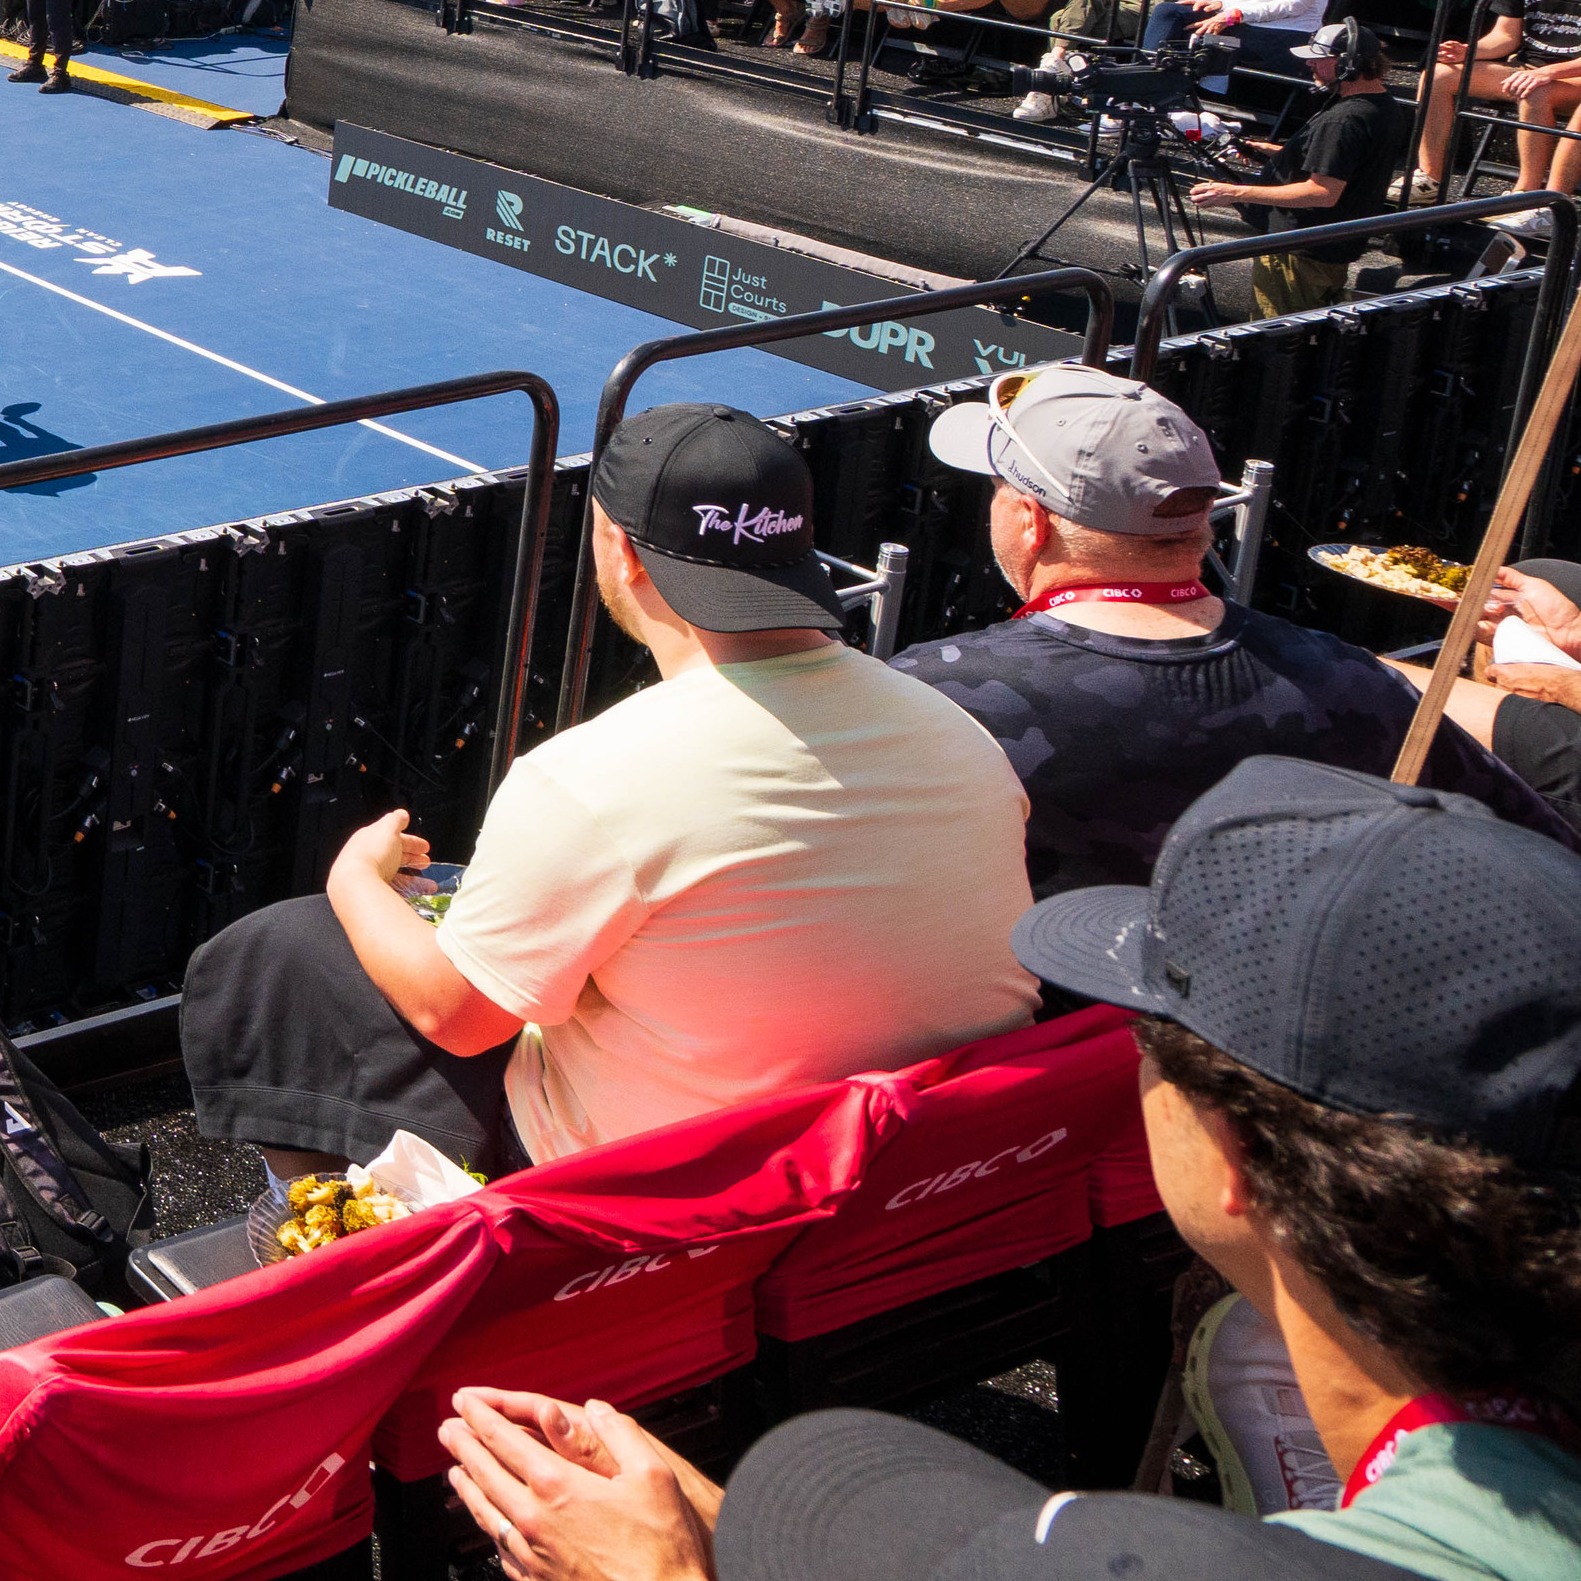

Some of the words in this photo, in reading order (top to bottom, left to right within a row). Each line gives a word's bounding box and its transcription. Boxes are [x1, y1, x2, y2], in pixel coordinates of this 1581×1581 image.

[364, 162, 468, 210] PICKLEBALL
[486, 227, 531, 252] RESET
[732, 267, 768, 290] Just
[730, 285, 788, 314] Courts
[692, 504, 733, 535] The
[733, 503, 803, 545] Kitchen
[1048, 594, 1066, 607] CIBC
[1102, 588, 1132, 598] CIBC
[1170, 588, 1190, 598] CIBC
[884, 1145, 1021, 1211] CIBC
[553, 1254, 671, 1302] CIBC
[124, 1493, 292, 1568] CIBC
